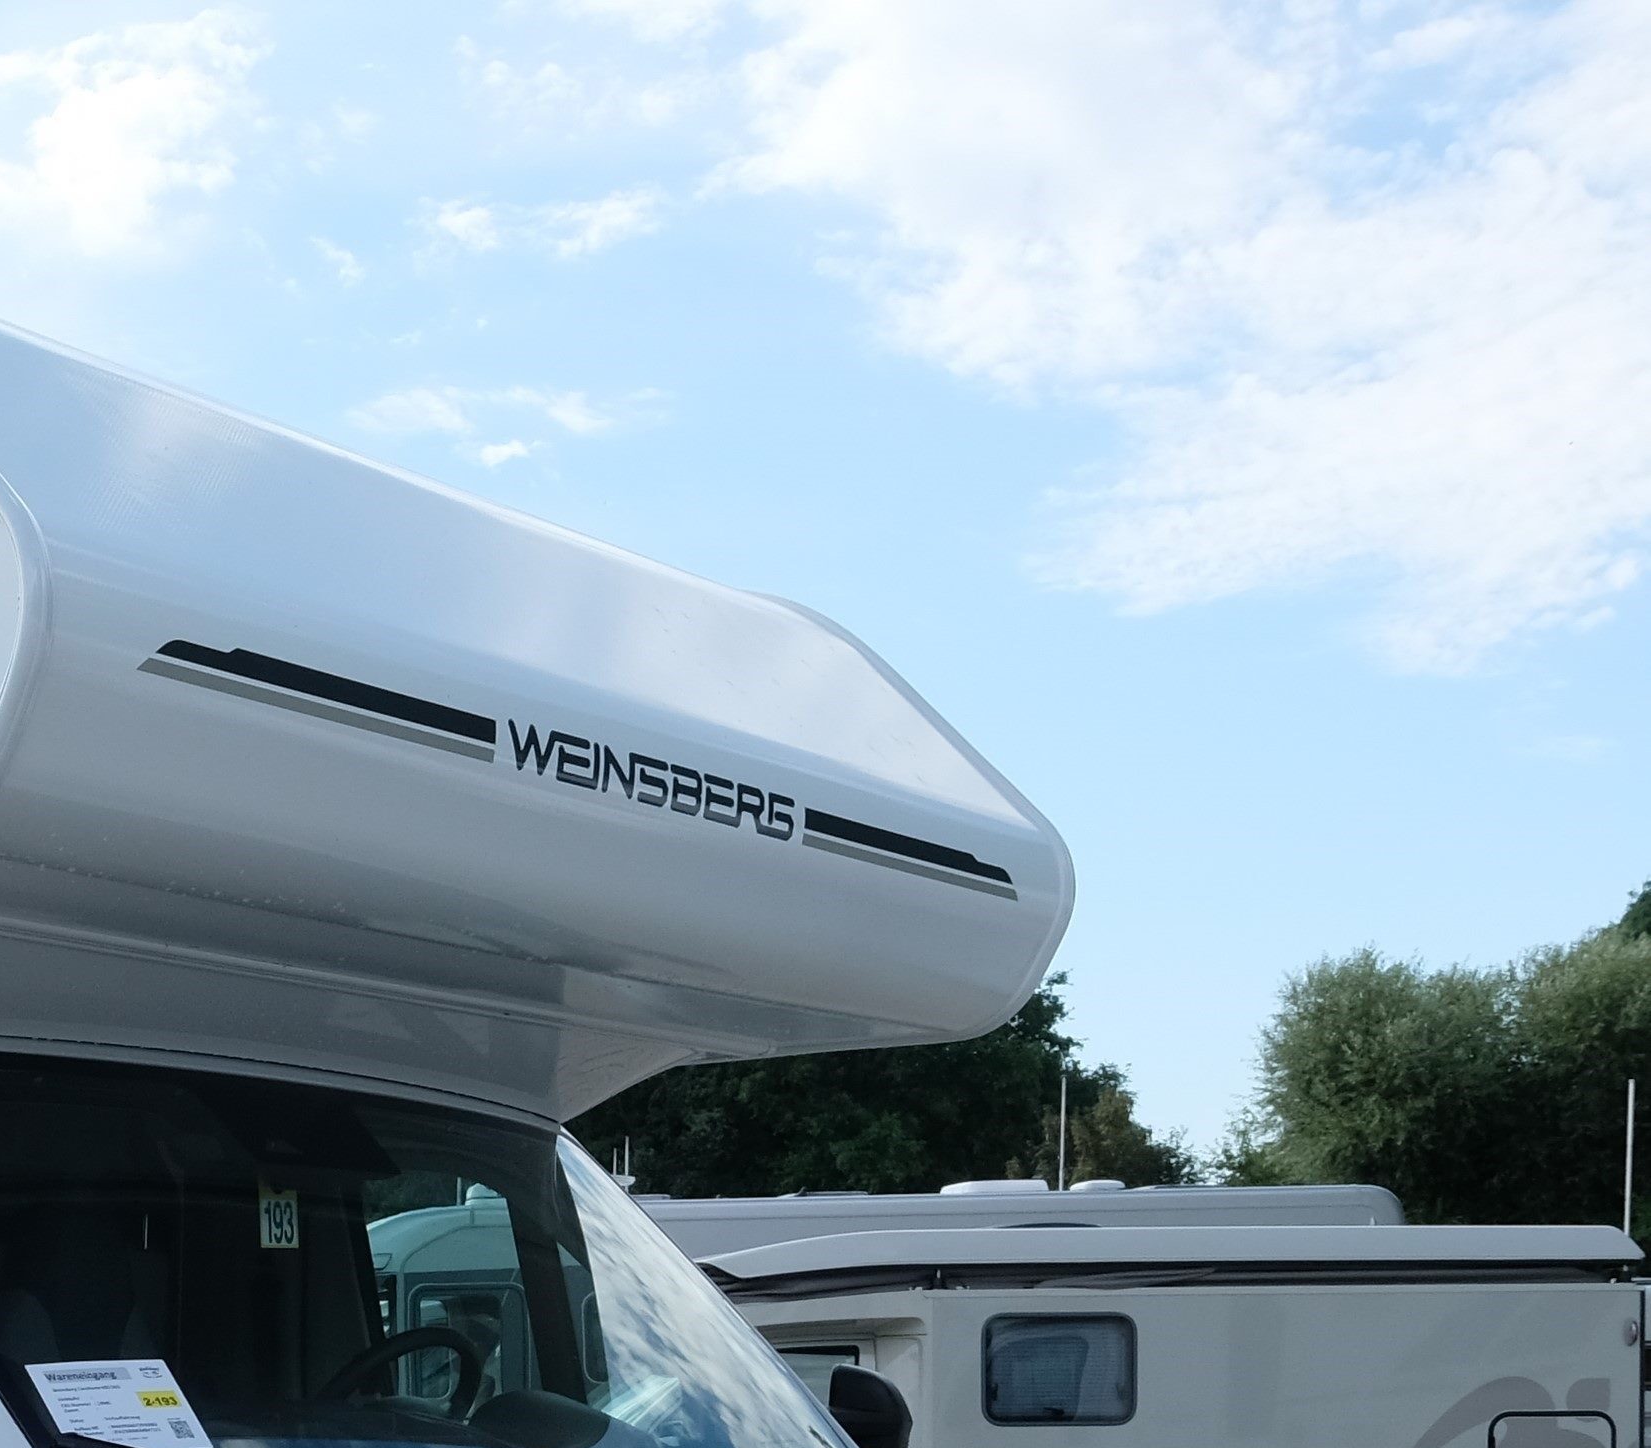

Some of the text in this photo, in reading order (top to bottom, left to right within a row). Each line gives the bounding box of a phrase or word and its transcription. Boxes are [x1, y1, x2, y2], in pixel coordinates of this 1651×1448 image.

[508, 718, 795, 842] WEINSBERG
[264, 1200, 295, 1244] 193
[44, 1371, 117, 1381] Wareneingang
